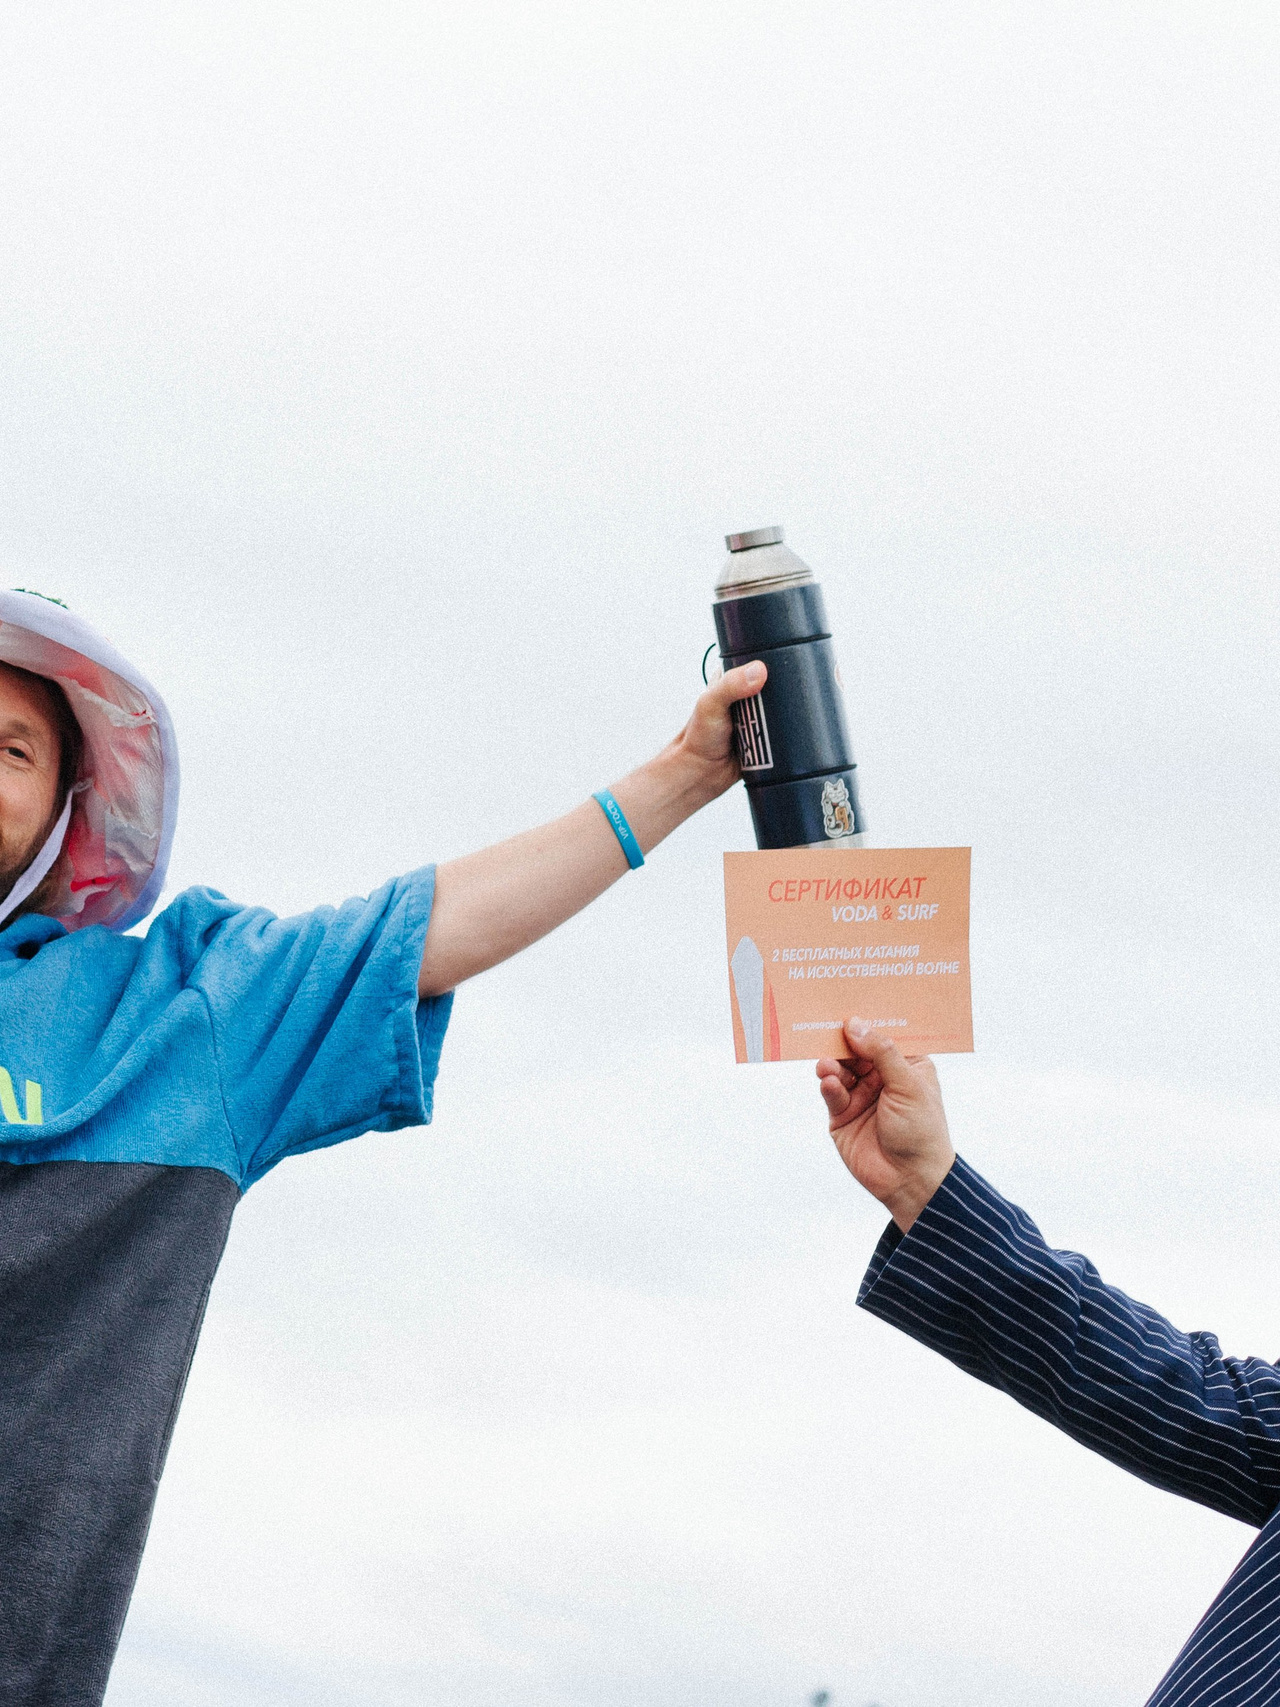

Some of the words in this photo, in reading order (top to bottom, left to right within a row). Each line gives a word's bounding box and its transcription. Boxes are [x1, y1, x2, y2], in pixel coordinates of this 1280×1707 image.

[768, 876, 928, 903] СЕРТИФИКАТ
[831, 905, 878, 923] VODA
[881, 904, 893, 921] &
[896, 903, 939, 921] SURF
[772, 948, 780, 963] 2
[782, 946, 861, 962] БЕСПЛАТНЫХ
[864, 944, 920, 959] КАТАНИЯ
[788, 966, 805, 980] НА
[807, 960, 915, 979] ИСКУССТВЕННОЙ
[916, 961, 960, 976] ВОЛНЕ
